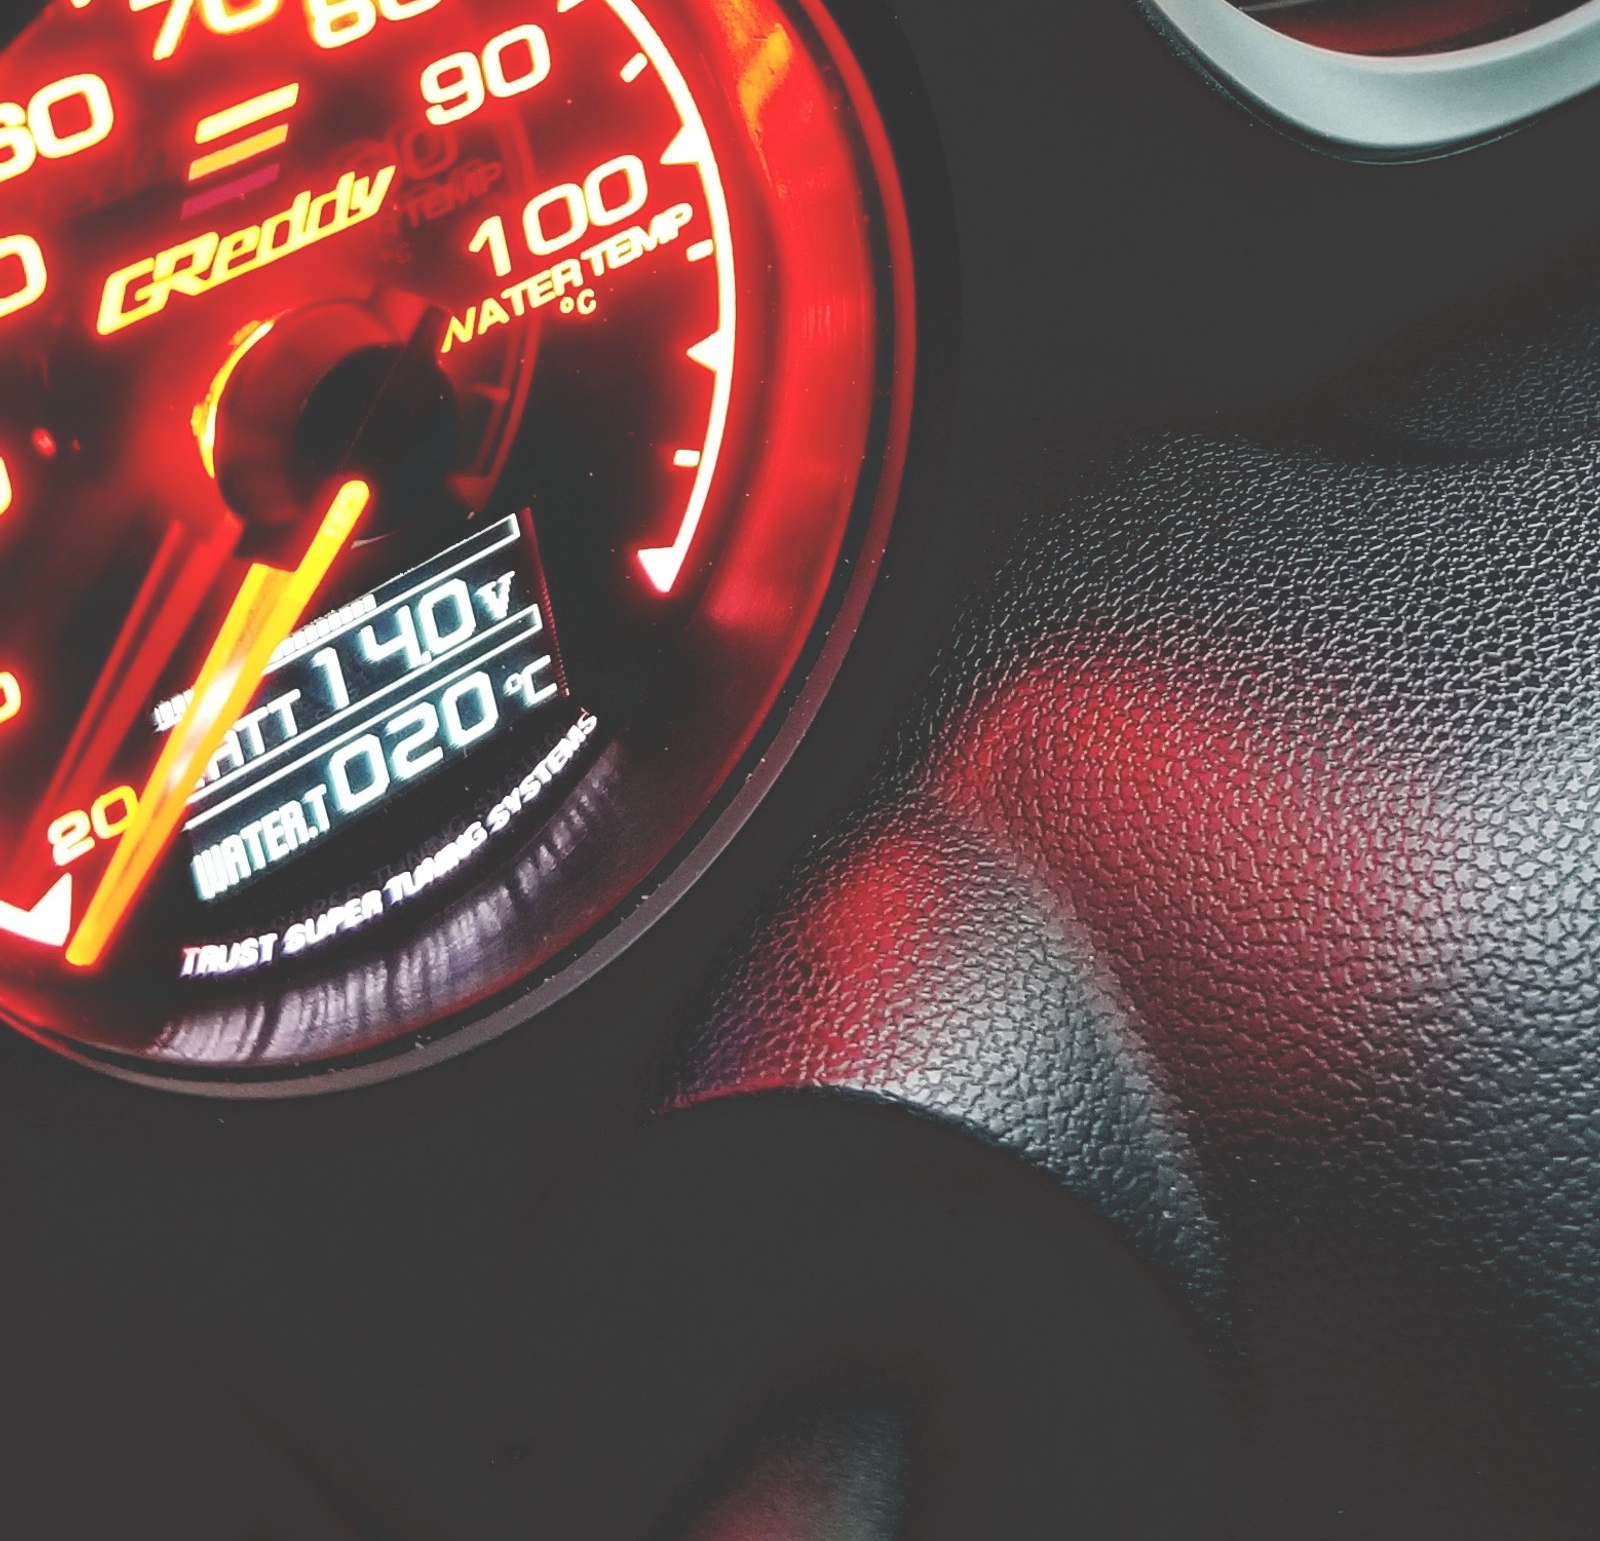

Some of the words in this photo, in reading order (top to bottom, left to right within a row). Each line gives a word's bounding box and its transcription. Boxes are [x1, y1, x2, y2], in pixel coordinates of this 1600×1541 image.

[420, 23, 552, 126] 90
[468, 154, 648, 277] 100
[580, 202, 693, 276] TEMP
[192, 688, 302, 787] ATT
[47, 785, 140, 867] 20
[181, 933, 278, 977] TRUST
[282, 889, 384, 955] SUPER
[383, 820, 488, 906] TUNING
[486, 714, 598, 835] SYSTEMS
